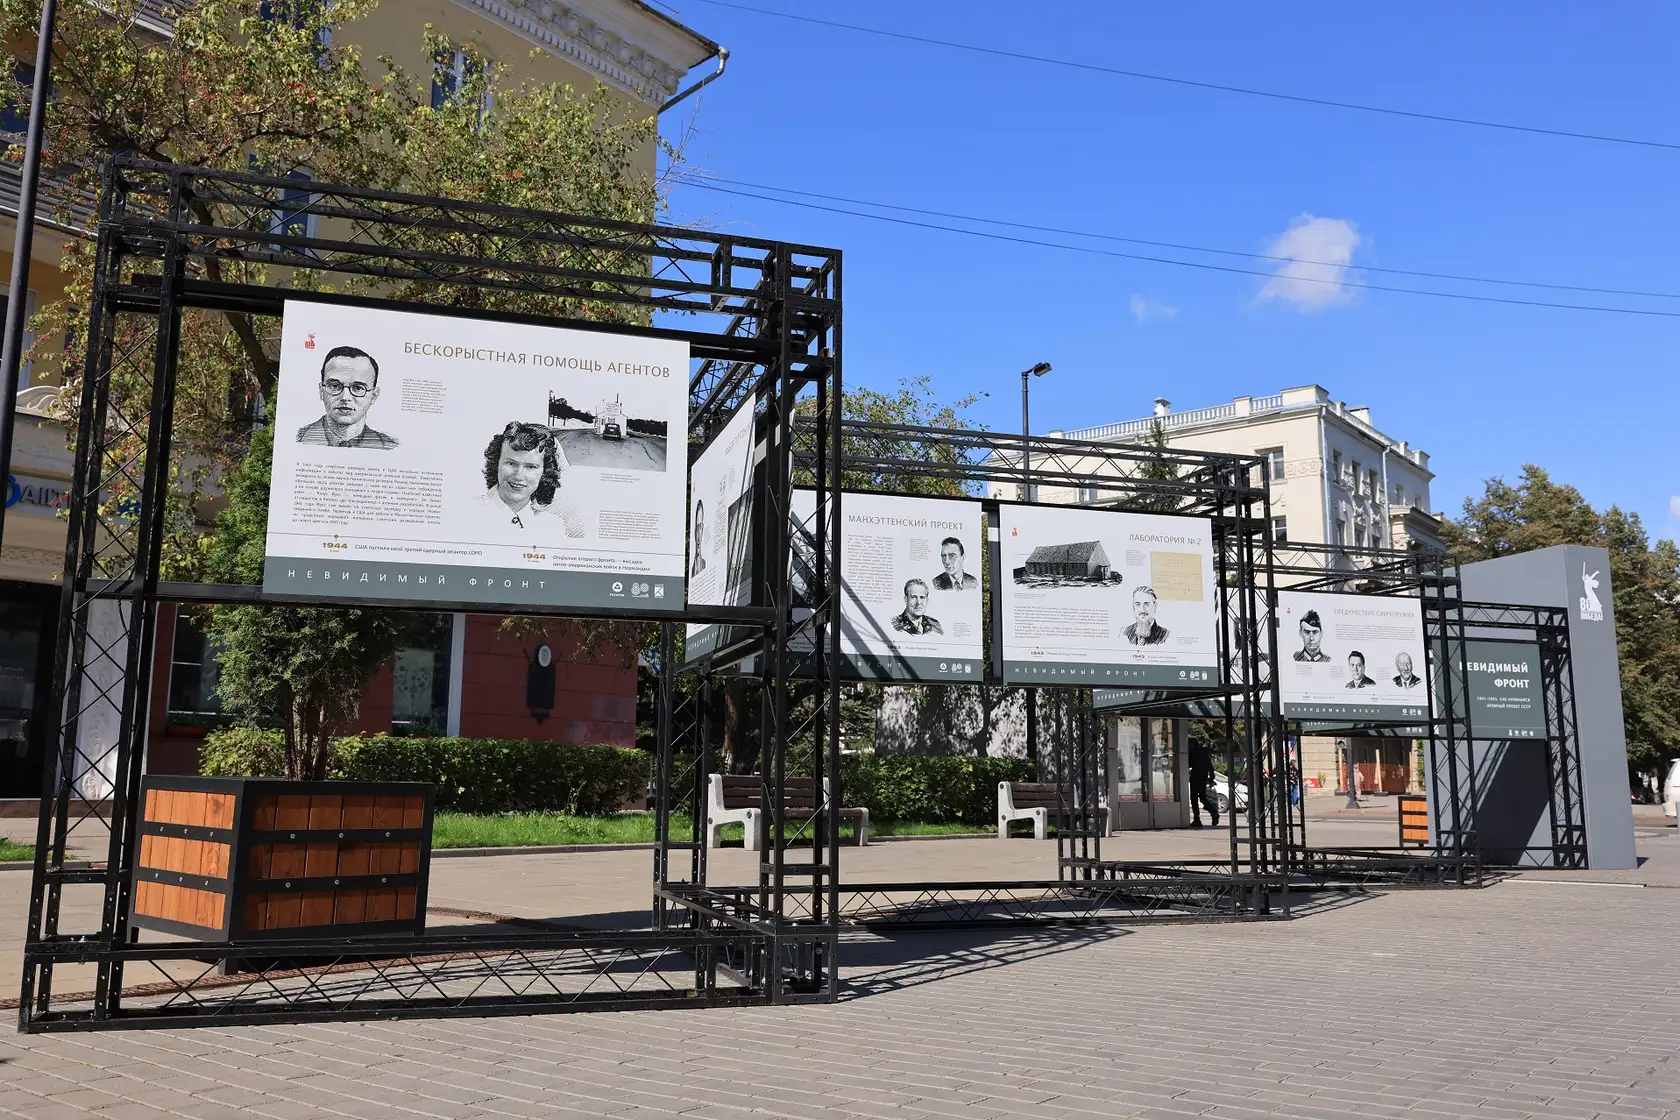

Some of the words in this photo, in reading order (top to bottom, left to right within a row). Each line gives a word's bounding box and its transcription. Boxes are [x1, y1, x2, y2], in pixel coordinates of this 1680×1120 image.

[404, 342, 527, 364] БЕСКОРЫСТНАЯ
[532, 354, 603, 373] ПОМОЩЬ
[607, 362, 671, 378] АГЕНТОВ
[848, 515, 928, 528] МАНХЭТТЕНСКИЙ
[930, 520, 964, 530] ПРОЕКТ
[1129, 534, 1185, 544] ЛАБОРАТОРИЯ
[1187, 537, 1196, 545] №
[288, 569, 445, 585] НЕВИДИМЫЙ
[469, 577, 546, 589] ФРОНТ
[1334, 608, 1375, 617] ПРЕДЧУВСТВИЕ
[1014, 668, 1095, 676] НЕВИДИМЫЙ
[1105, 669, 1147, 677] ФРОНТ
[1494, 678, 1530, 688] ФРОНТ
